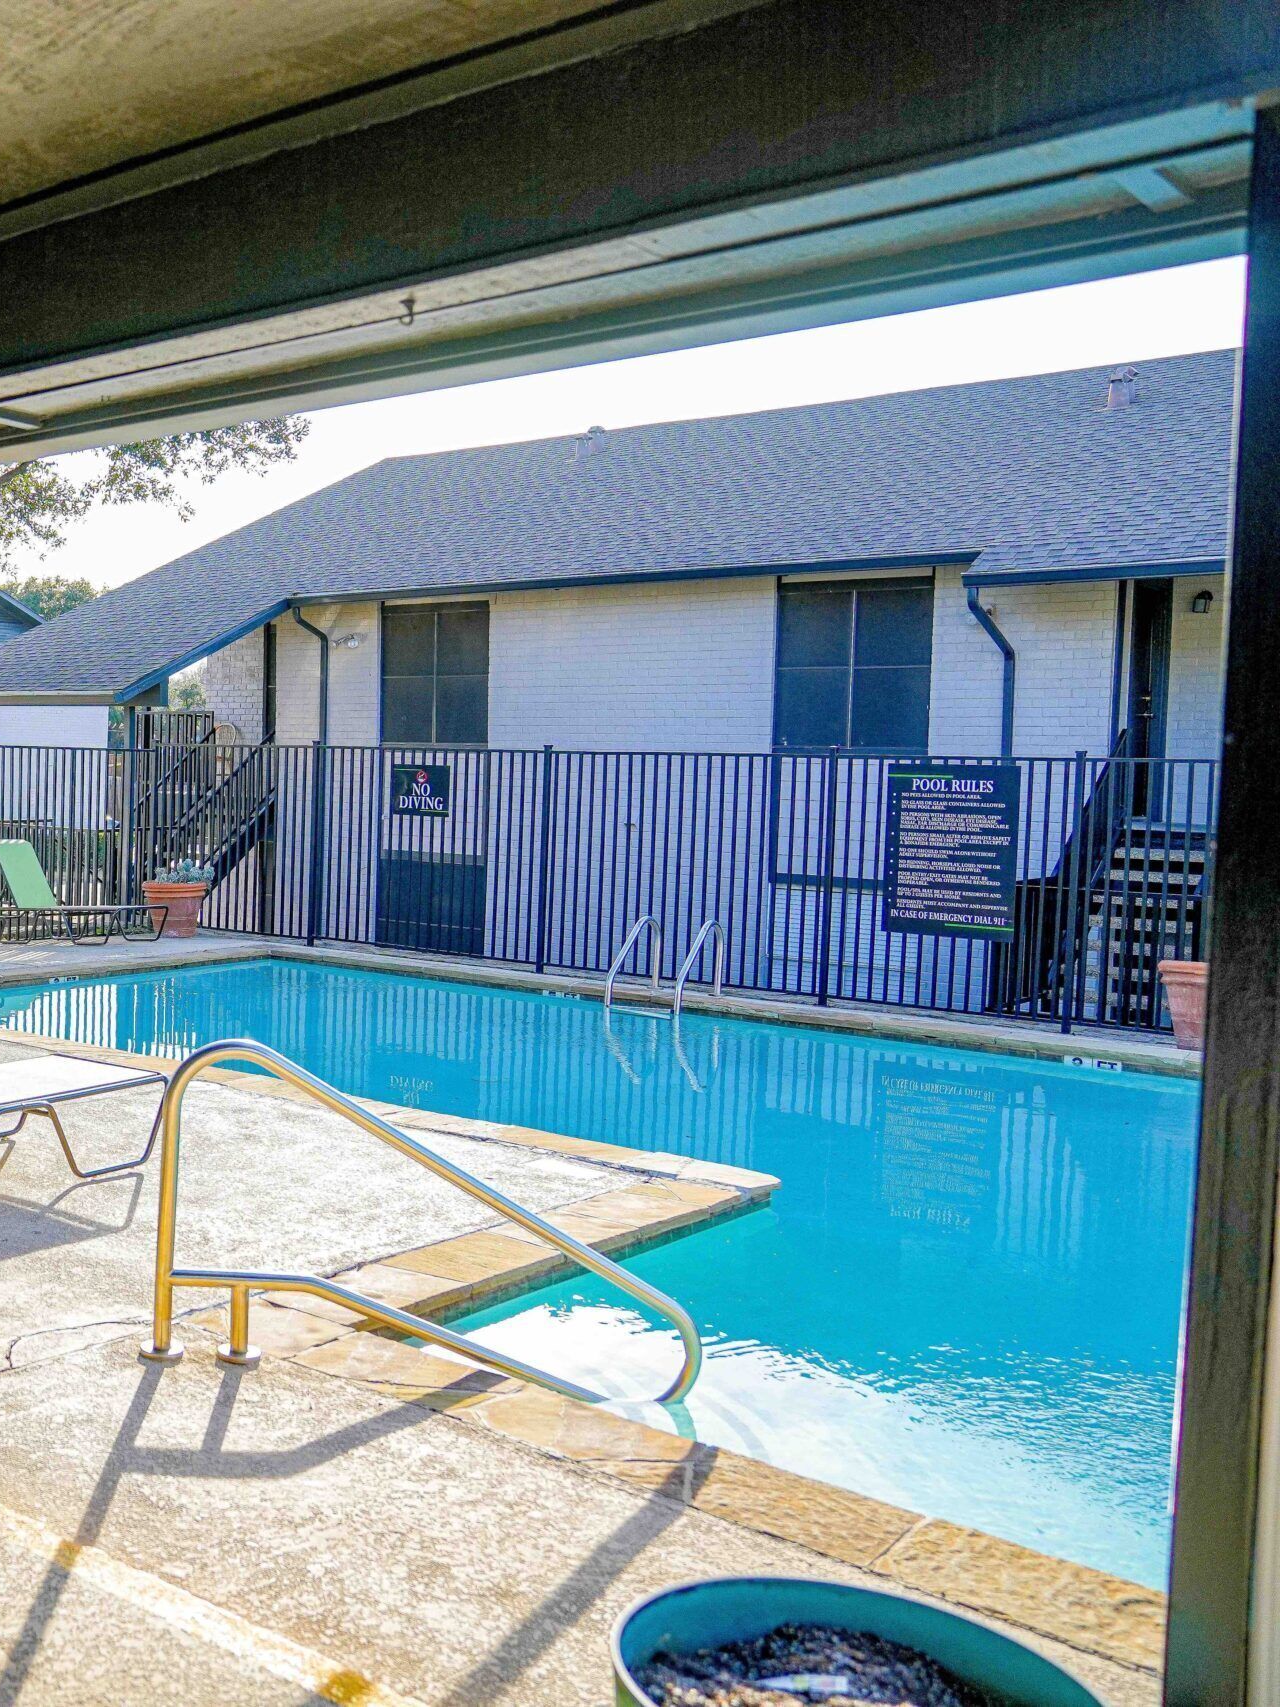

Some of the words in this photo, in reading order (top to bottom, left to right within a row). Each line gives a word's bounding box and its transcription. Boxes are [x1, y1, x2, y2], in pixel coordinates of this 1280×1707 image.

[412, 783, 430, 796] NO
[912, 778, 948, 791] POOL
[951, 779, 993, 792] RULES
[399, 796, 444, 810] DIVING
[899, 909, 917, 918] CASE
[929, 912, 972, 922] EMERGENCY
[974, 915, 992, 924] DIAL
[993, 917, 1004, 925] 911
